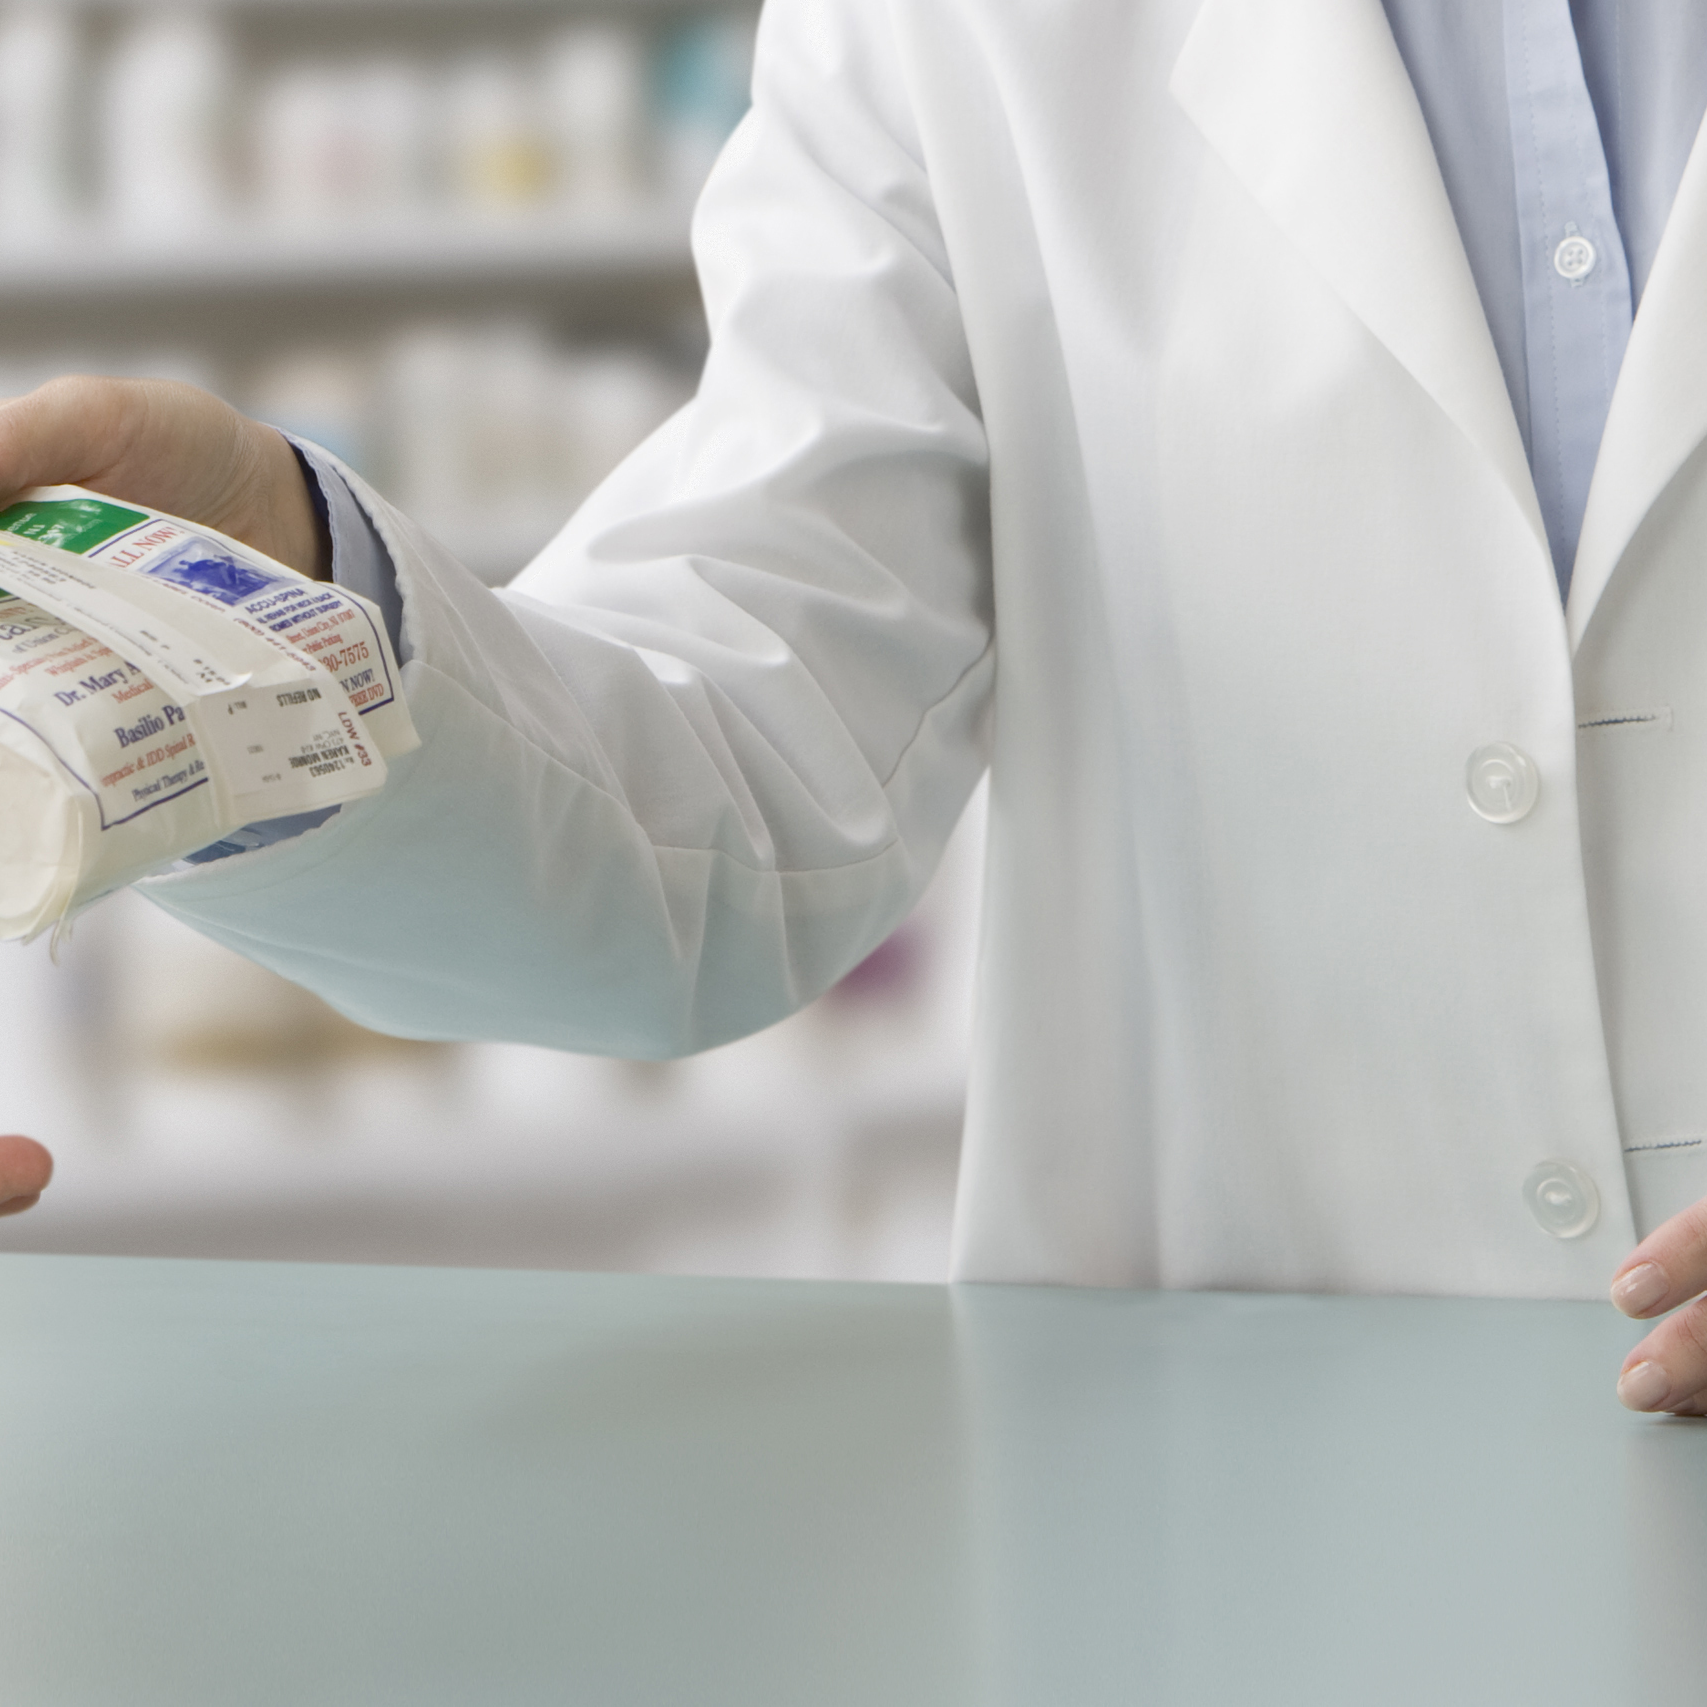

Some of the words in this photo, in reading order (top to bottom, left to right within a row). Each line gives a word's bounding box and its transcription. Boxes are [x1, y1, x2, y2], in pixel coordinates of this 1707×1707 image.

[54, 690, 87, 707] Dr.
[79, 668, 129, 695] Mary
[111, 677, 155, 704] Medical
[306, 687, 322, 702] NO
[366, 682, 385, 701] DVD
[276, 690, 308, 707] REFILLS
[114, 714, 165, 749] Basilio
[288, 752, 322, 770] MONROE
[320, 744, 350, 761] KAREN
